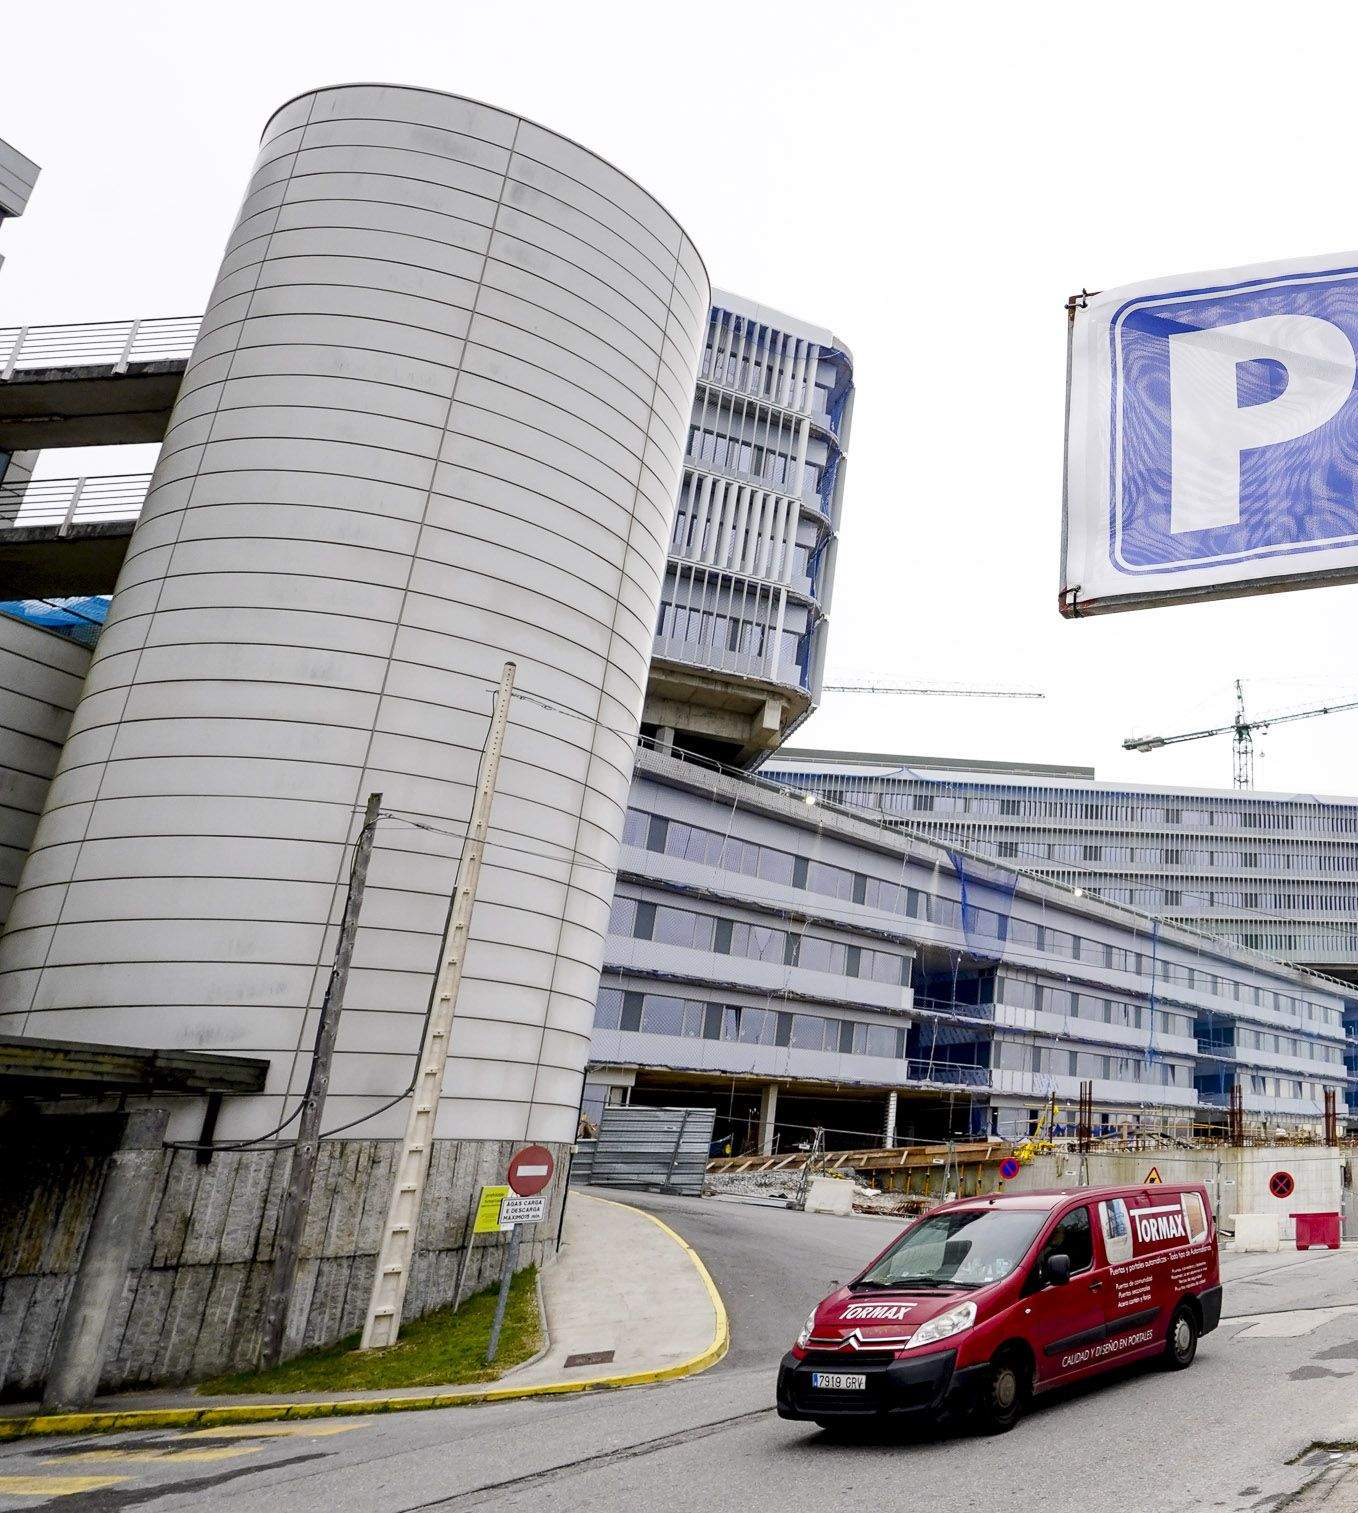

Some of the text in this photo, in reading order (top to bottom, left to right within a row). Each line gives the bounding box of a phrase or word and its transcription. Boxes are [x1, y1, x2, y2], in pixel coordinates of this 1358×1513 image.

[1168, 313, 1358, 535] P
[1129, 1204, 1186, 1243] TORMAX
[1109, 1267, 1125, 1276] Puertas
[1128, 1262, 1145, 1273] portales
[839, 1302, 918, 1320] TORMAX
[1061, 1329, 1153, 1367] CALIDAD Y DISEÑO EN PORTALES
[819, 1375, 863, 1389] 7919 GRV
